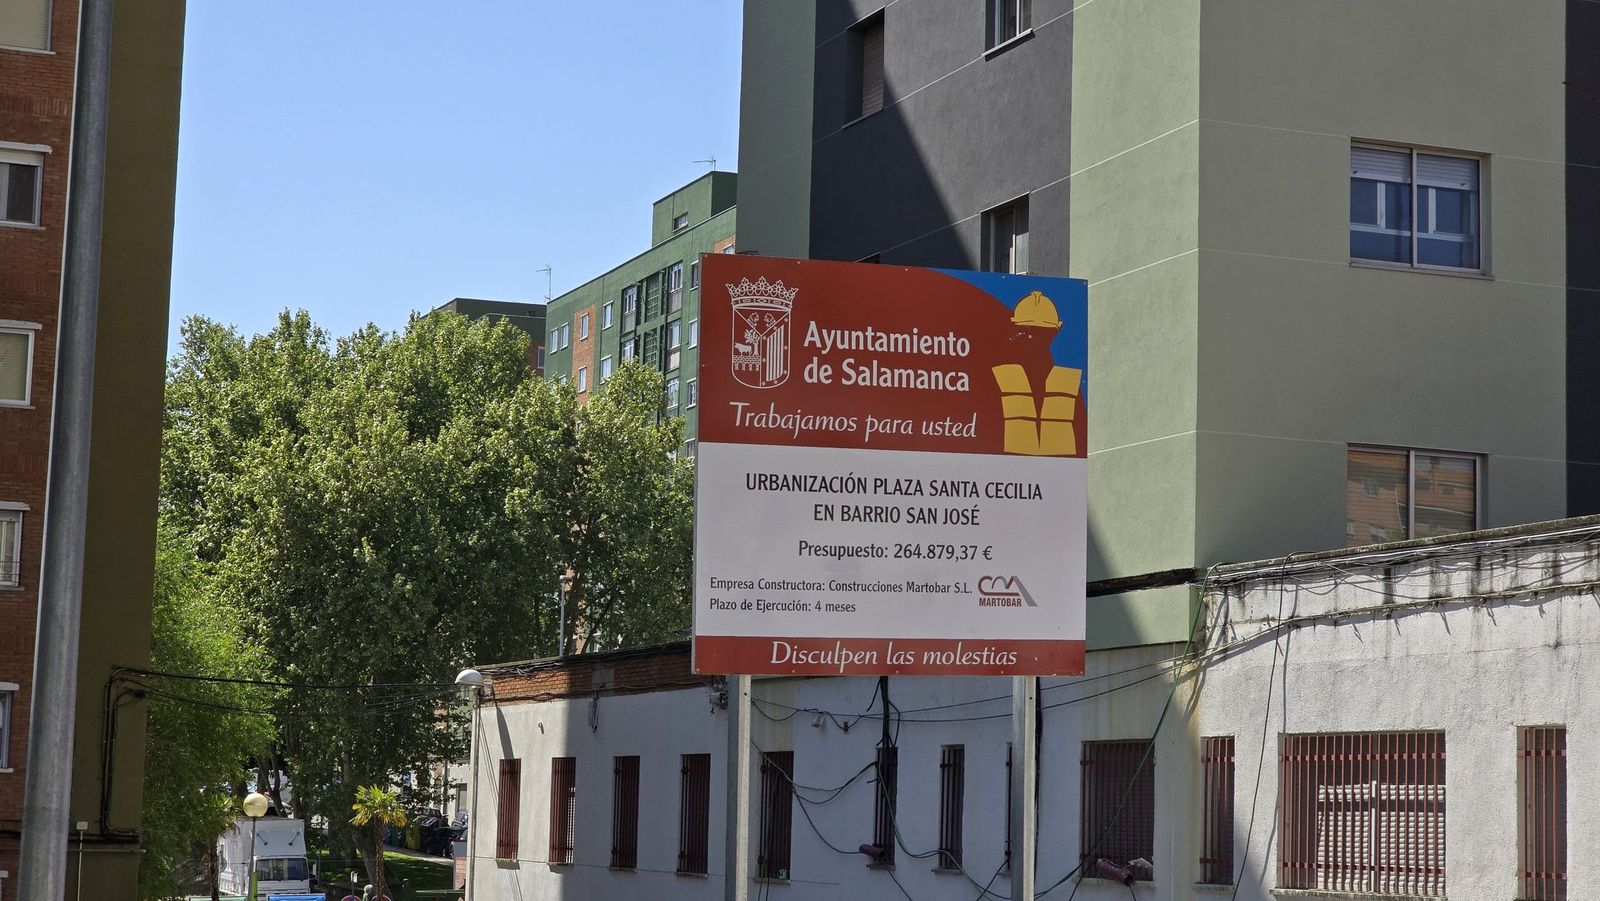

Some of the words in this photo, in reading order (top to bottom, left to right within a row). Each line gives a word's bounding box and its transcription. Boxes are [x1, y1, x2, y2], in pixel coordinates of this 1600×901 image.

[804, 321, 969, 357] Ayuntamiento
[804, 357, 832, 384] de
[842, 358, 969, 391] Salamanca
[730, 402, 857, 439] Trabajamos
[865, 415, 913, 442] para
[922, 413, 976, 437] usted
[747, 472, 866, 494] URBANIZACIÓN
[874, 478, 923, 496] PLAZA
[930, 480, 979, 497] SANTA
[985, 482, 1042, 500] CECILIA
[814, 504, 834, 521] EN
[841, 505, 900, 523] BARRIO
[907, 507, 937, 524] SAN
[943, 505, 979, 525] JOSÉ
[799, 541, 888, 560] Presupuesto:
[894, 544, 977, 562] 264.879,37
[983, 545, 993, 561] €
[711, 576, 755, 592] Empresa
[758, 578, 825, 592] Constructora:
[829, 579, 903, 593] Construcciones
[907, 581, 952, 594] Martobar
[954, 581, 973, 594] S.L.
[710, 597, 737, 611] Plazo
[741, 598, 753, 611] de
[757, 598, 811, 614] Ejercución:
[815, 600, 822, 612] 4
[826, 603, 857, 613] meses
[979, 597, 1022, 608] MARTOBAR
[771, 641, 877, 673] Disculpen
[887, 641, 914, 664] las
[923, 642, 1017, 664] molestias
